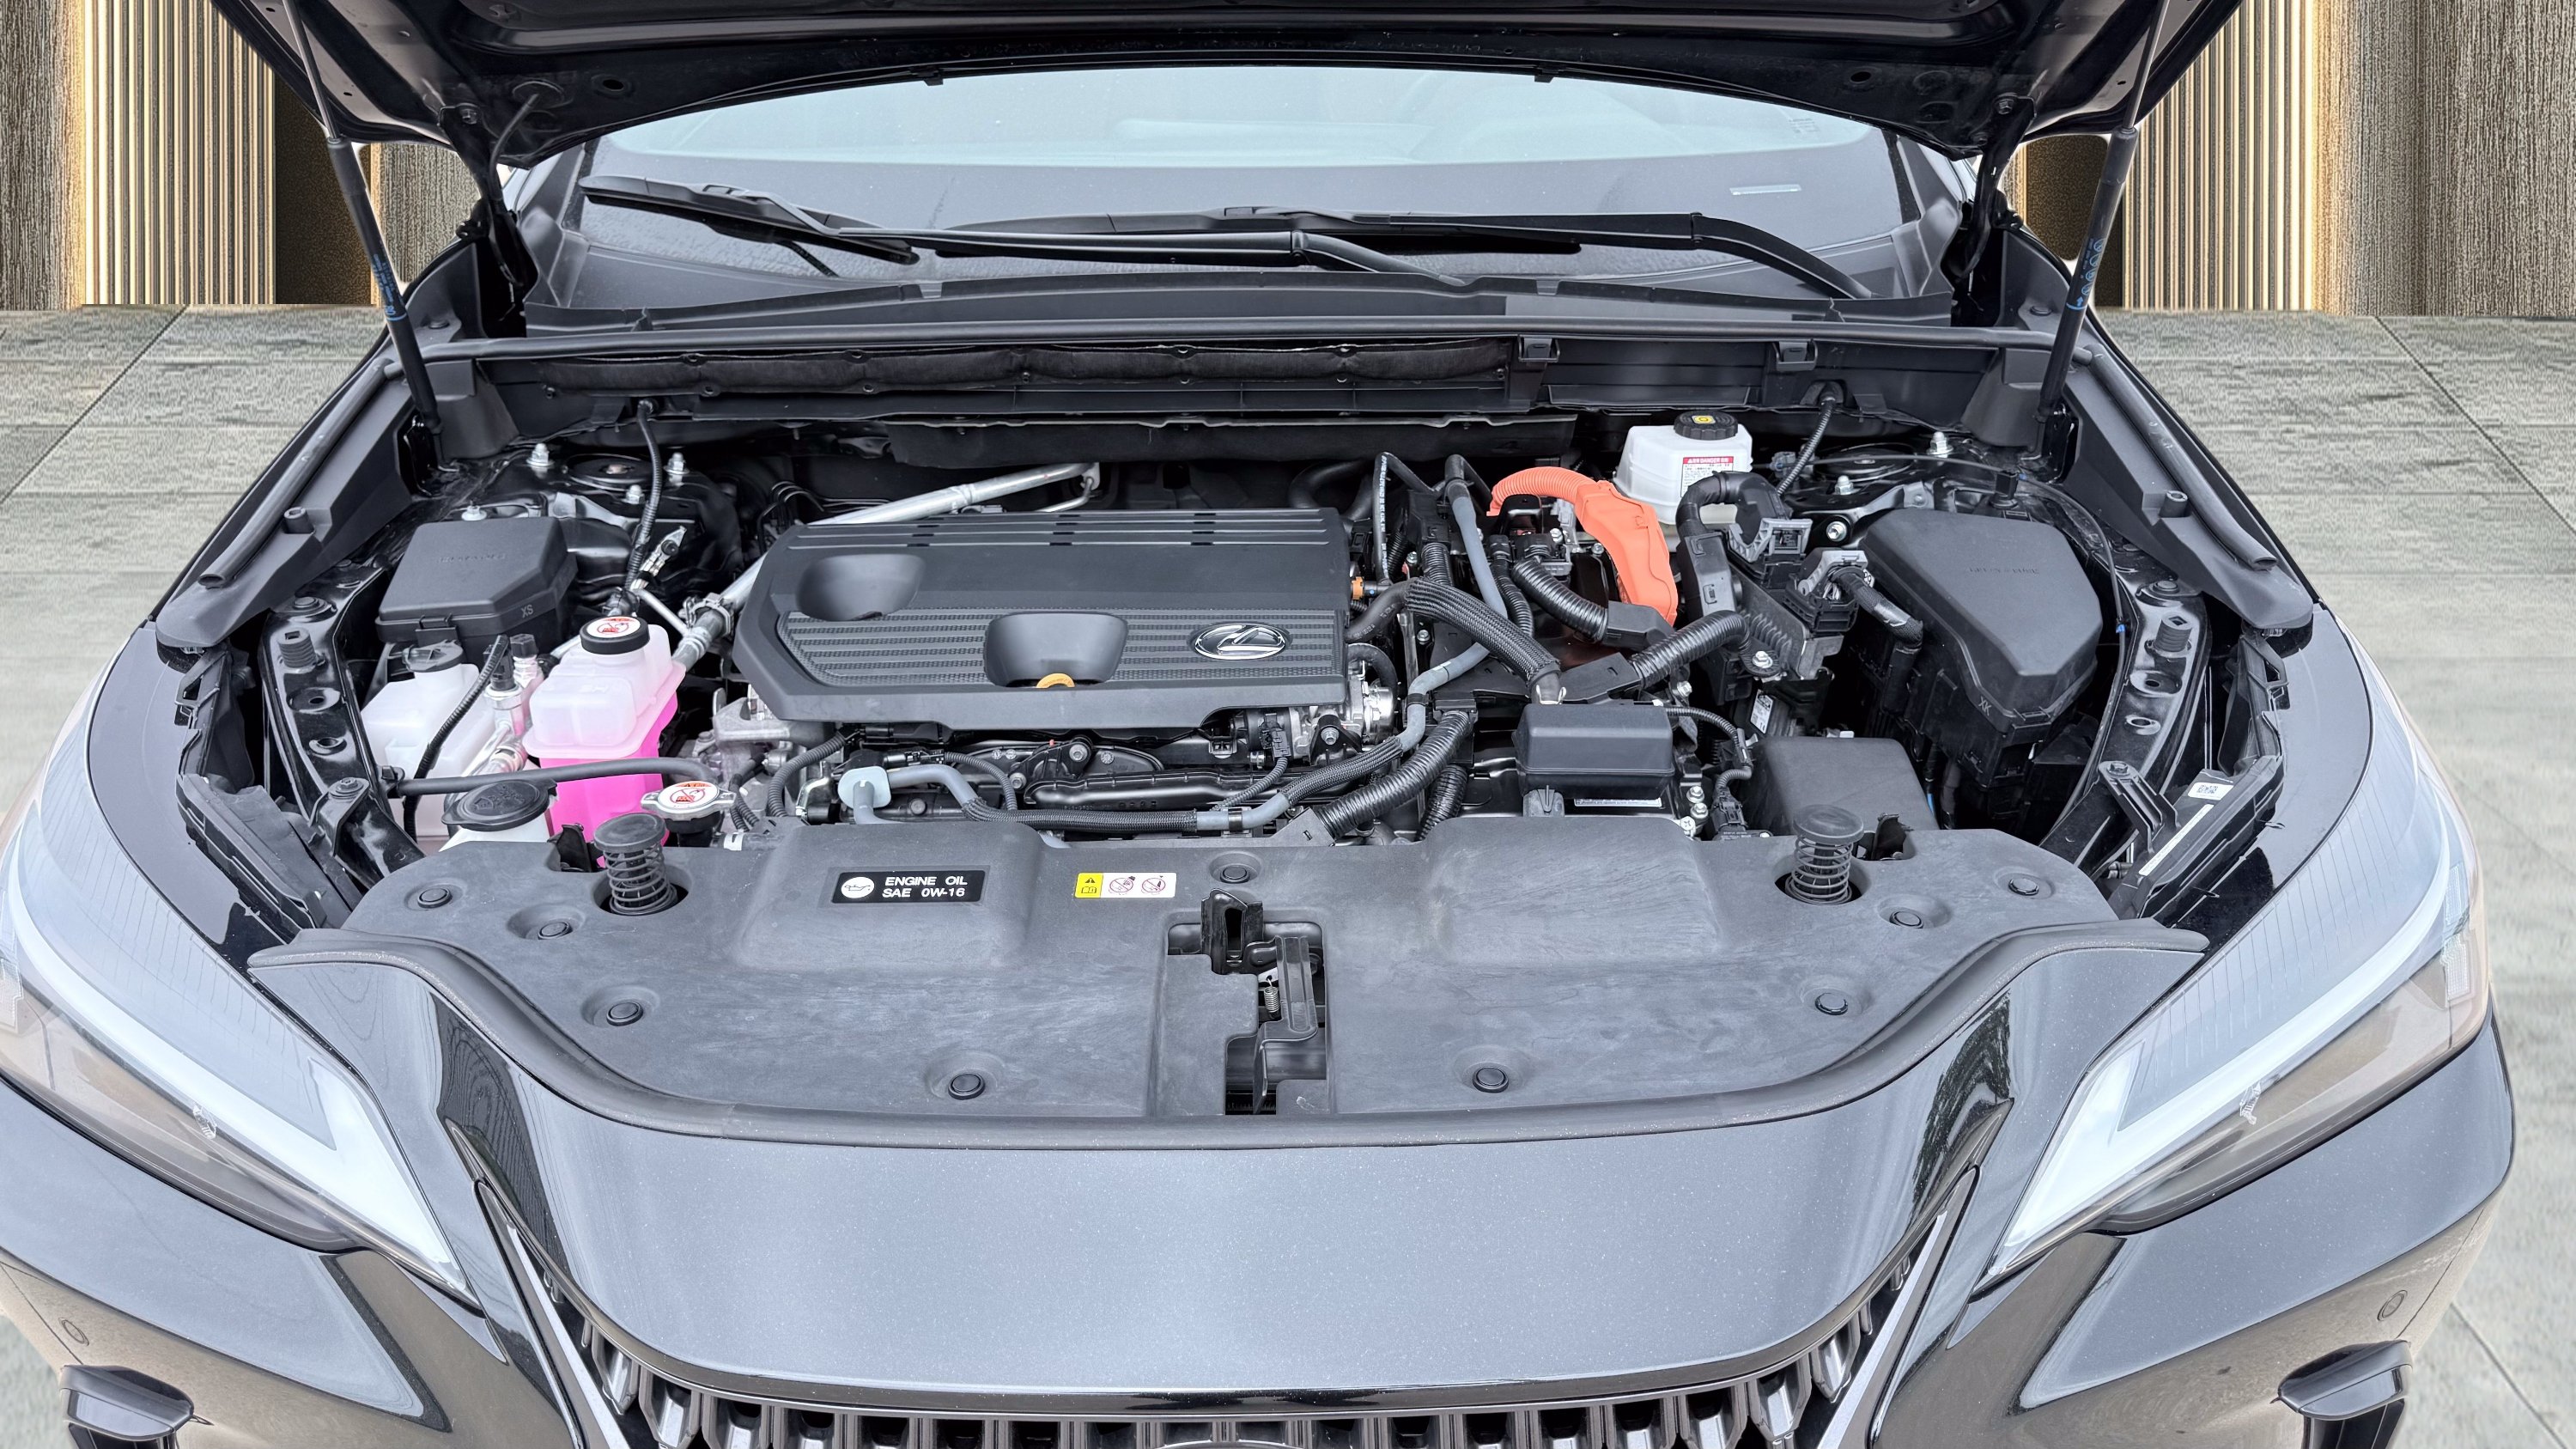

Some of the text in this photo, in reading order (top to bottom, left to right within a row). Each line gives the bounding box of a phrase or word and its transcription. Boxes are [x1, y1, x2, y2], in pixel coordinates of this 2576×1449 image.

[520, 604, 533, 618] XS
[884, 876, 968, 886] ENGINE OIL
[882, 887, 965, 898] SAE 0W-16
